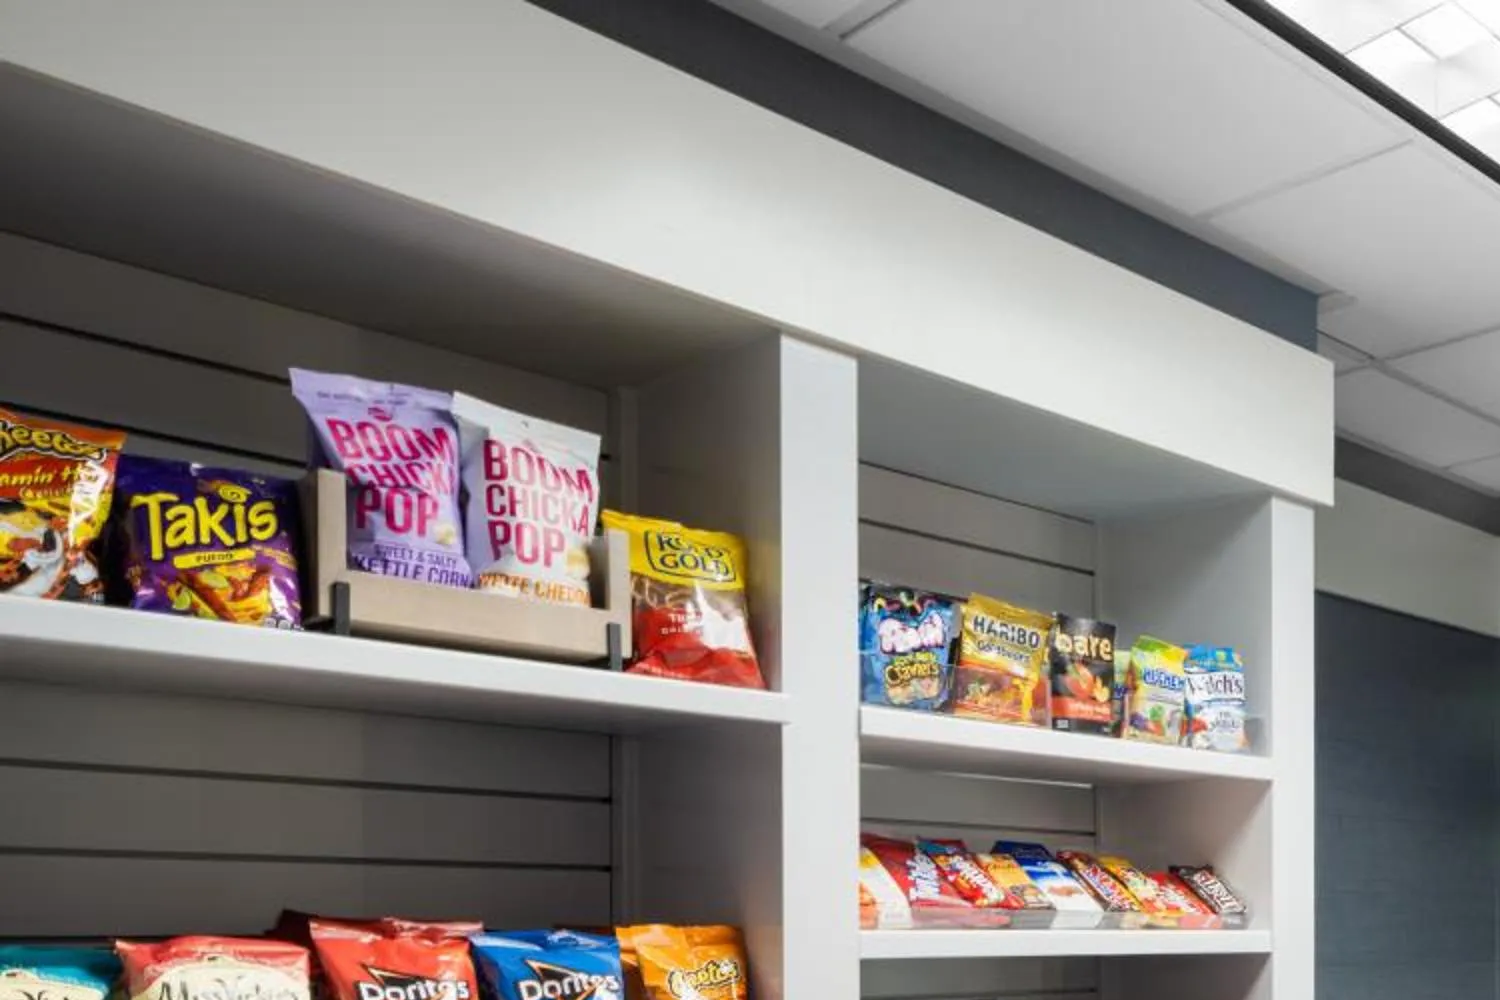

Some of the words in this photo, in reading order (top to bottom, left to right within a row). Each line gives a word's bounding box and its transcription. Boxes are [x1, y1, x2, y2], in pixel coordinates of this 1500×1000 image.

[325, 417, 451, 464] BOOM
[483, 438, 594, 504] BOOM
[130, 485, 279, 561] Takis
[356, 483, 439, 537] POP
[485, 484, 590, 537] CHICKA
[487, 520, 566, 568] POP
[659, 553, 730, 577] GOLD
[973, 615, 1041, 649] HARIBO
[1054, 625, 1112, 662] bare
